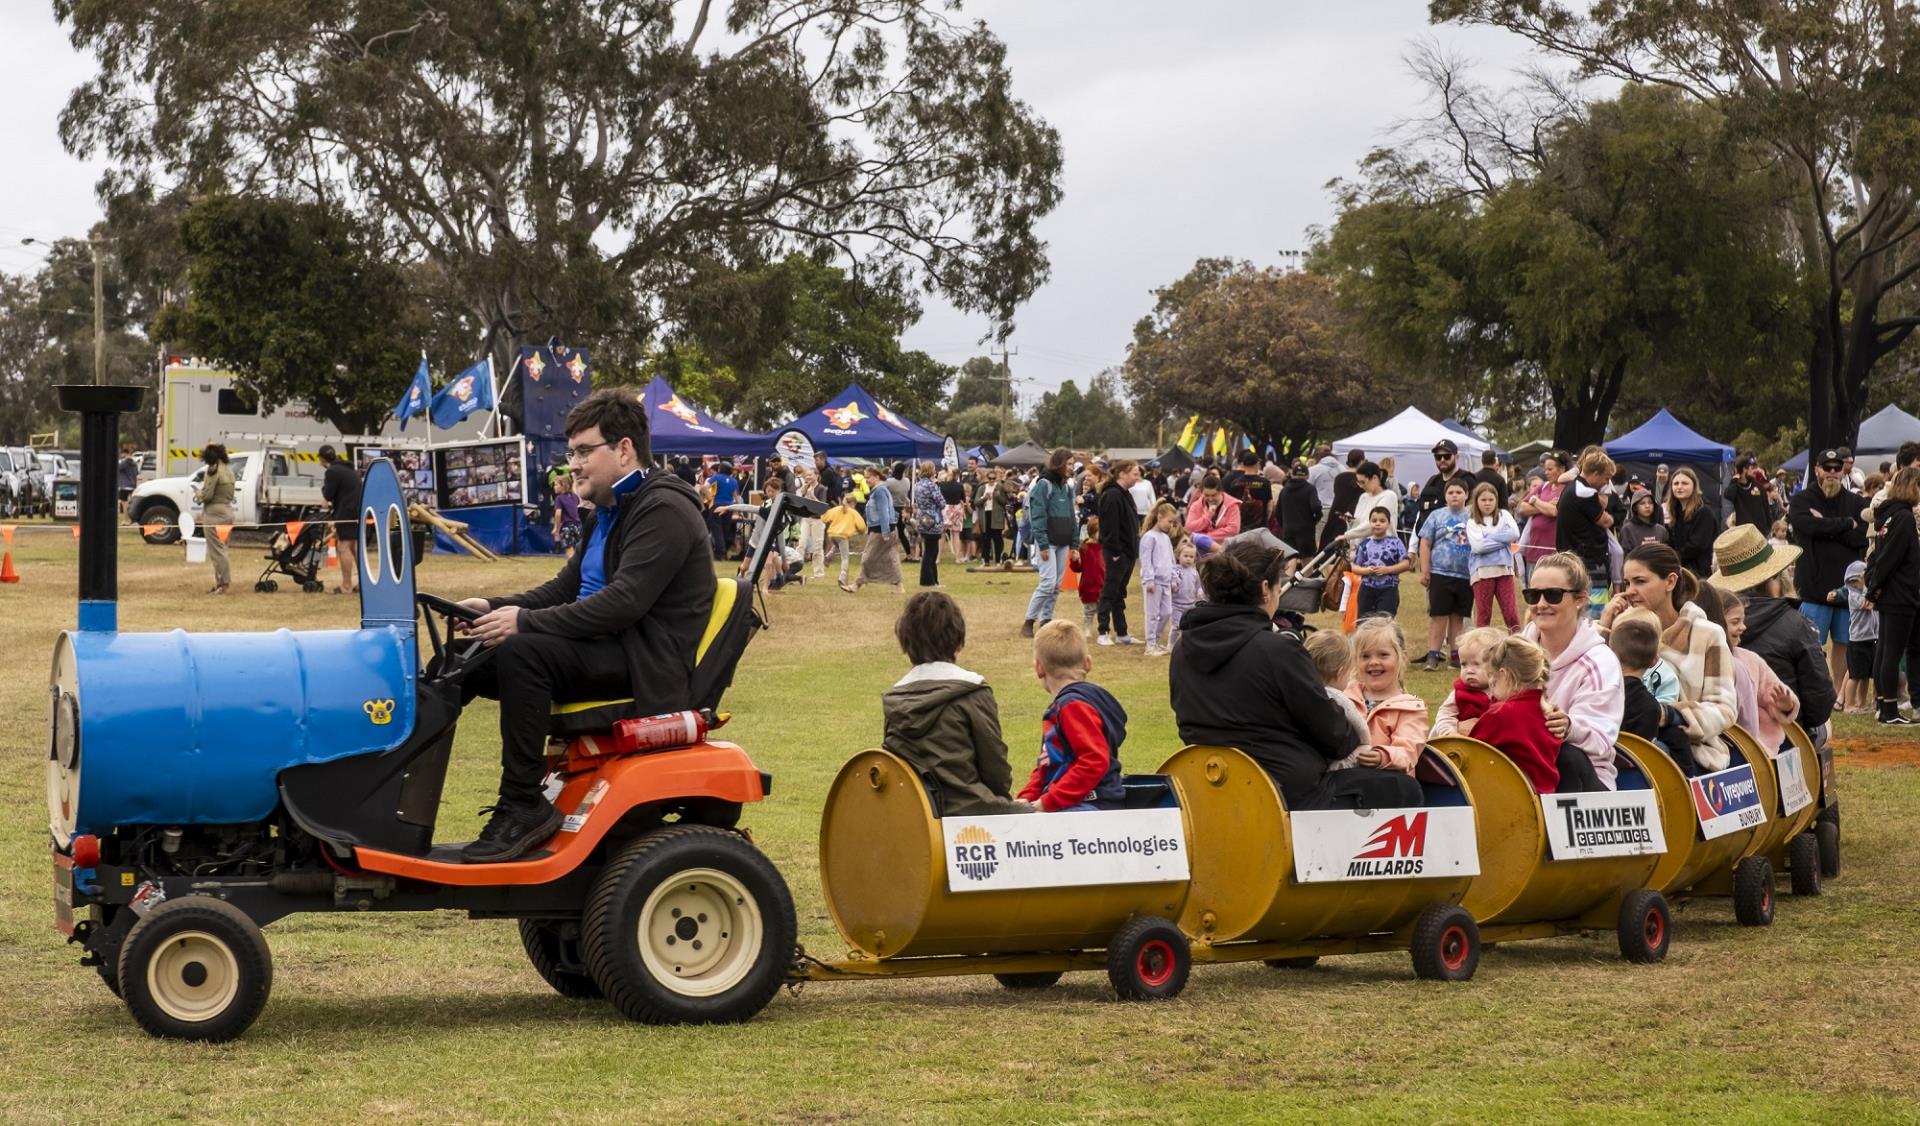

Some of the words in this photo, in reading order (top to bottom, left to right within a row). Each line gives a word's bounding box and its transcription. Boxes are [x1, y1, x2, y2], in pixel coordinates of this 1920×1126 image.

[1719, 779, 1755, 806] Tyrepower
[1556, 798, 1646, 848] TRIMVIEW
[1738, 807, 1763, 827] BUNBURY
[955, 844, 997, 862] RCR
[1006, 840, 1064, 860] Mining
[1068, 835, 1178, 856] Technologies
[1577, 829, 1651, 846] CERAMICS
[1346, 859, 1424, 877] MILLARDS
